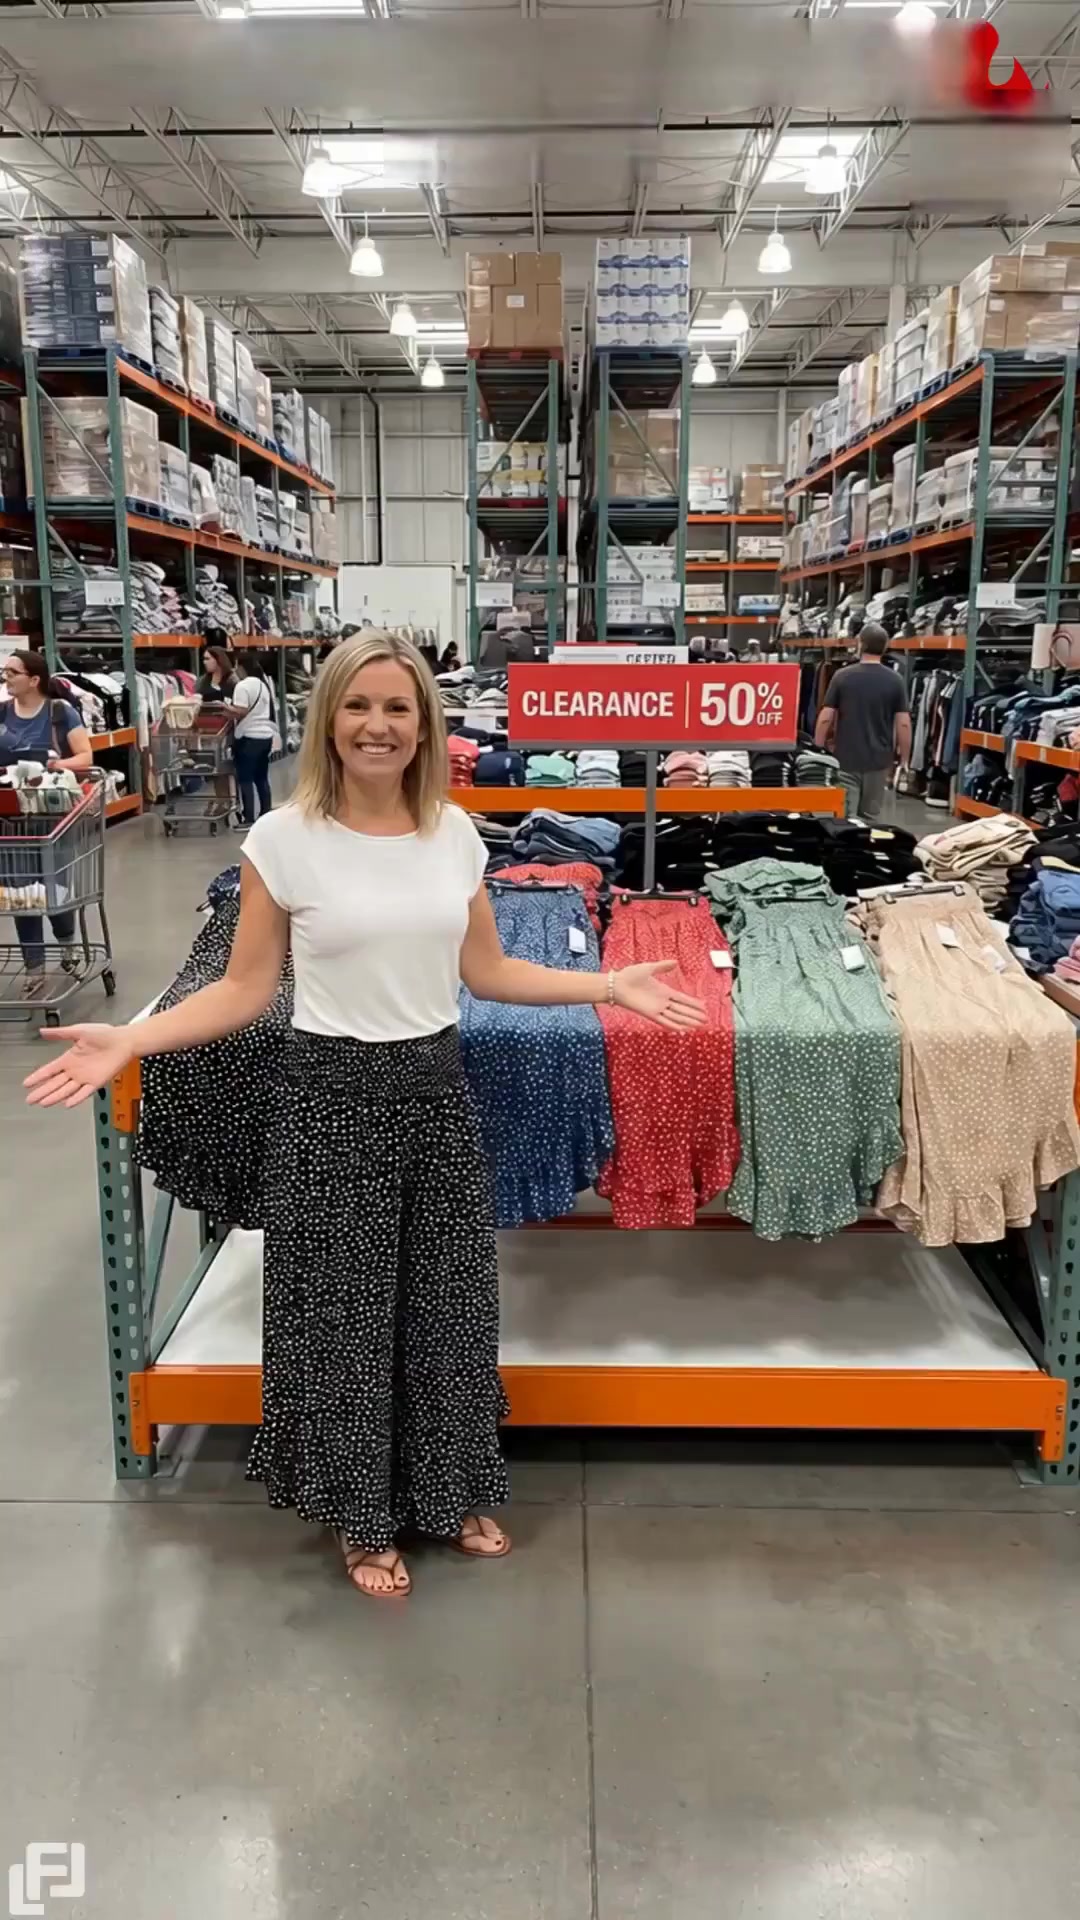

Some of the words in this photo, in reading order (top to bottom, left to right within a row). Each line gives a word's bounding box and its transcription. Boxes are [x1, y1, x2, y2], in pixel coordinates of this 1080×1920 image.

[522, 690, 674, 717] CLEARANCE
[700, 681, 784, 727] 50%
[757, 711, 783, 726] OFF
